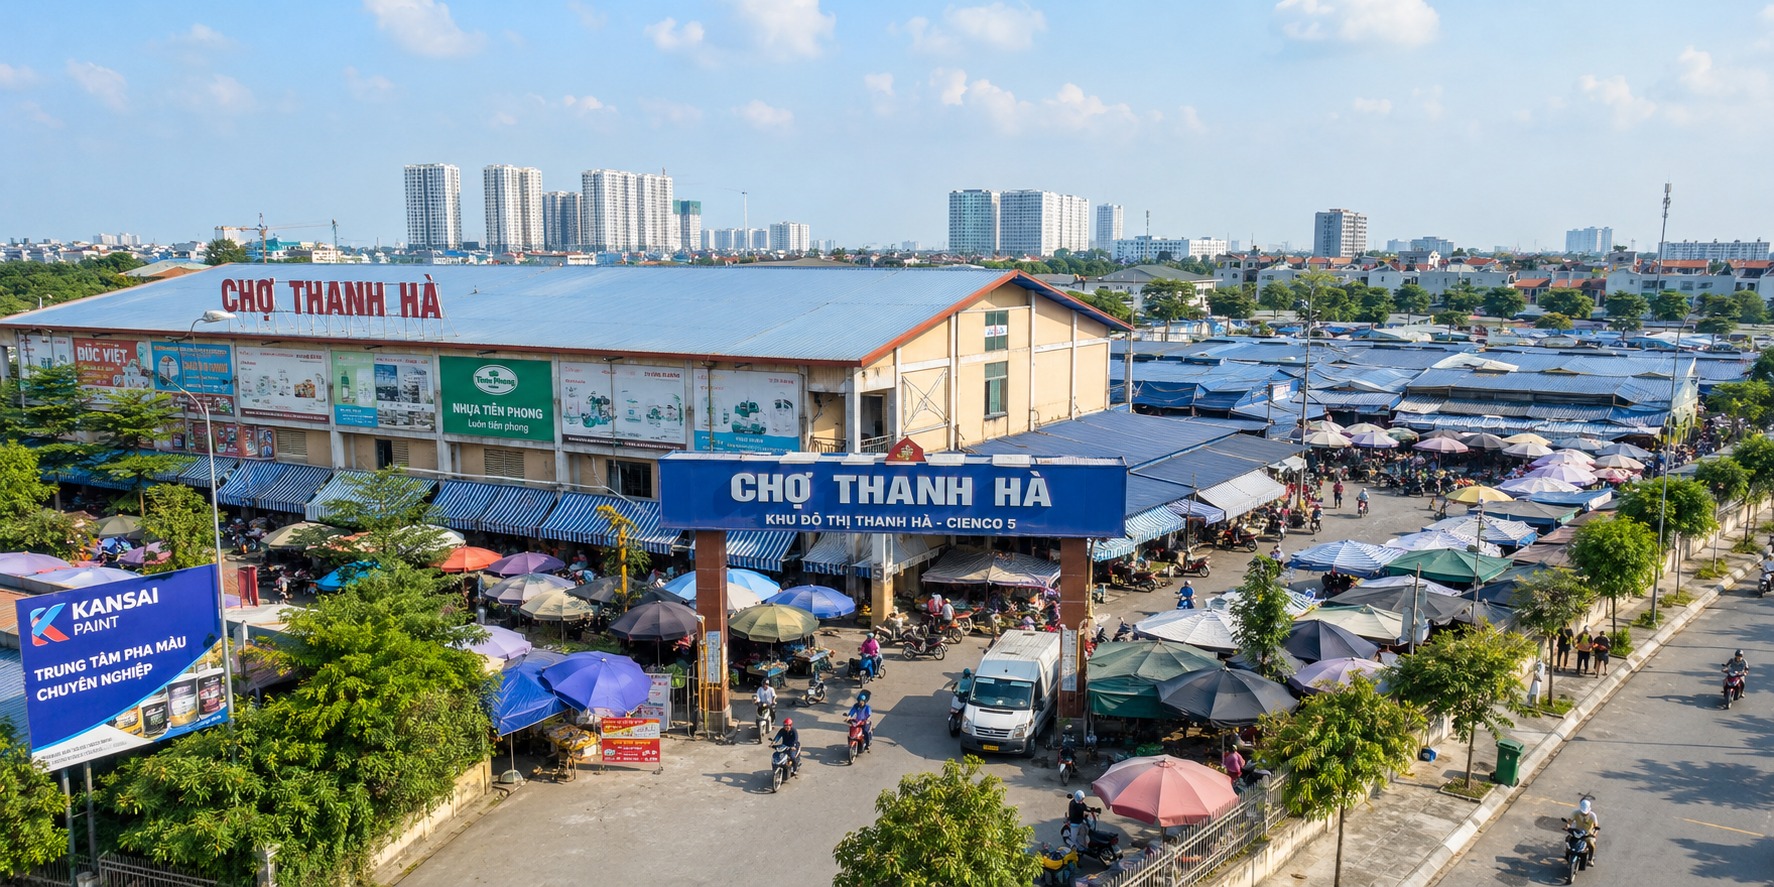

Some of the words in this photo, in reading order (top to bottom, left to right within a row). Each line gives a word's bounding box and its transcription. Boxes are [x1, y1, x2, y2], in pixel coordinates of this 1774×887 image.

[221, 277, 275, 321] CHỢ
[289, 280, 387, 317] THANH
[399, 273, 443, 319] HÀ
[452, 402, 481, 417] NHỰA
[507, 406, 543, 420] PHONG
[504, 422, 529, 434] phong
[730, 471, 813, 510] CHỢ
[833, 474, 973, 506] THANH
[994, 470, 1052, 507] HÀ
[765, 513, 796, 526] KHU
[826, 514, 850, 529] THỊ
[855, 515, 906, 528] THANH
[946, 517, 1003, 529] CIENCO
[1007, 518, 1016, 529] 5
[71, 587, 159, 621] KANSAI
[73, 615, 120, 636] PAINT
[34, 659, 87, 682] TRUNG
[89, 651, 121, 669] TÂM
[124, 643, 154, 661] PHA
[156, 635, 187, 654] MÀU
[36, 675, 98, 702] CHUYÊN
[101, 662, 153, 686] NGHIỆP
